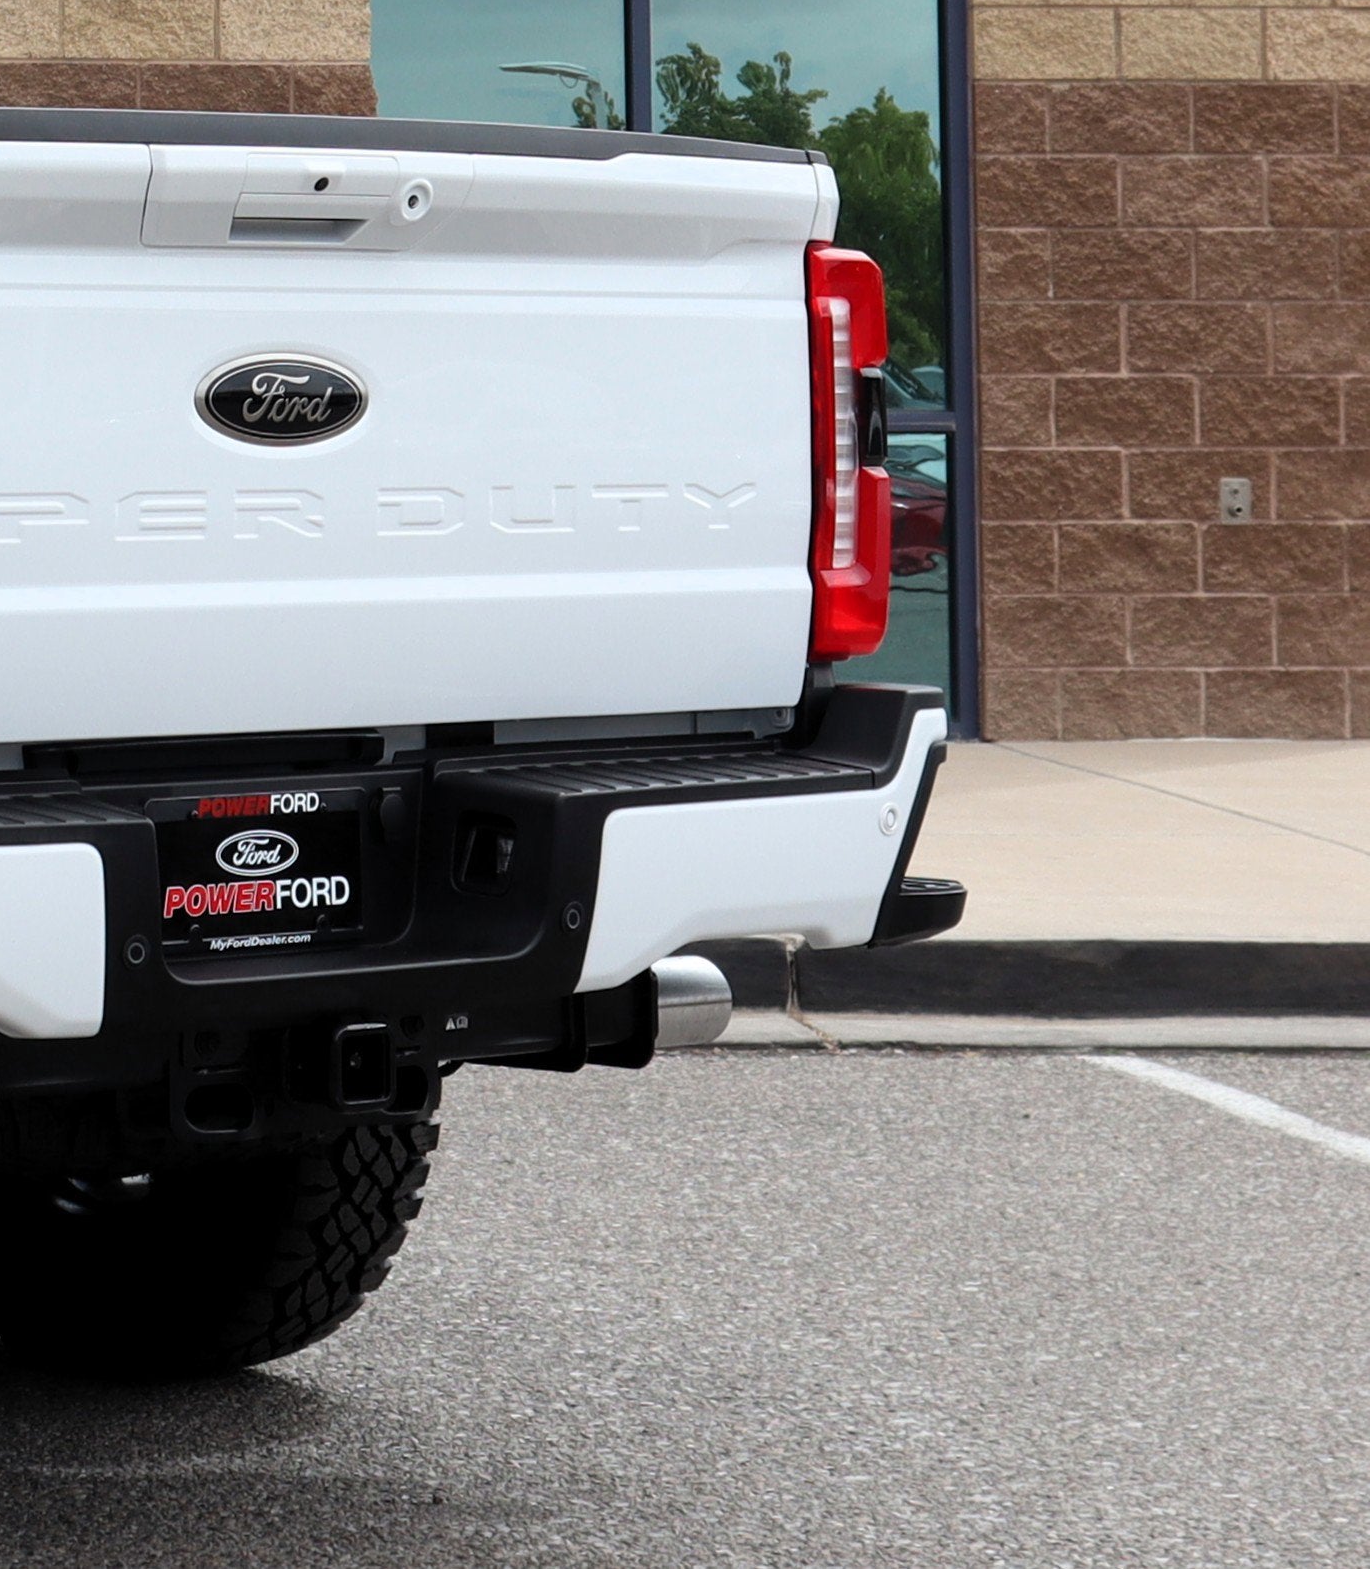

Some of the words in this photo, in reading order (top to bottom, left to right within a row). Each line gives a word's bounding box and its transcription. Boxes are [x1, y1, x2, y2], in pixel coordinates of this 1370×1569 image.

[241, 371, 333, 425] Ford
[374, 482, 758, 538] DUTY
[232, 838, 282, 866] Ford
[163, 875, 351, 918] POWERFORD
[209, 933, 312, 952] MyFordDealer.com
